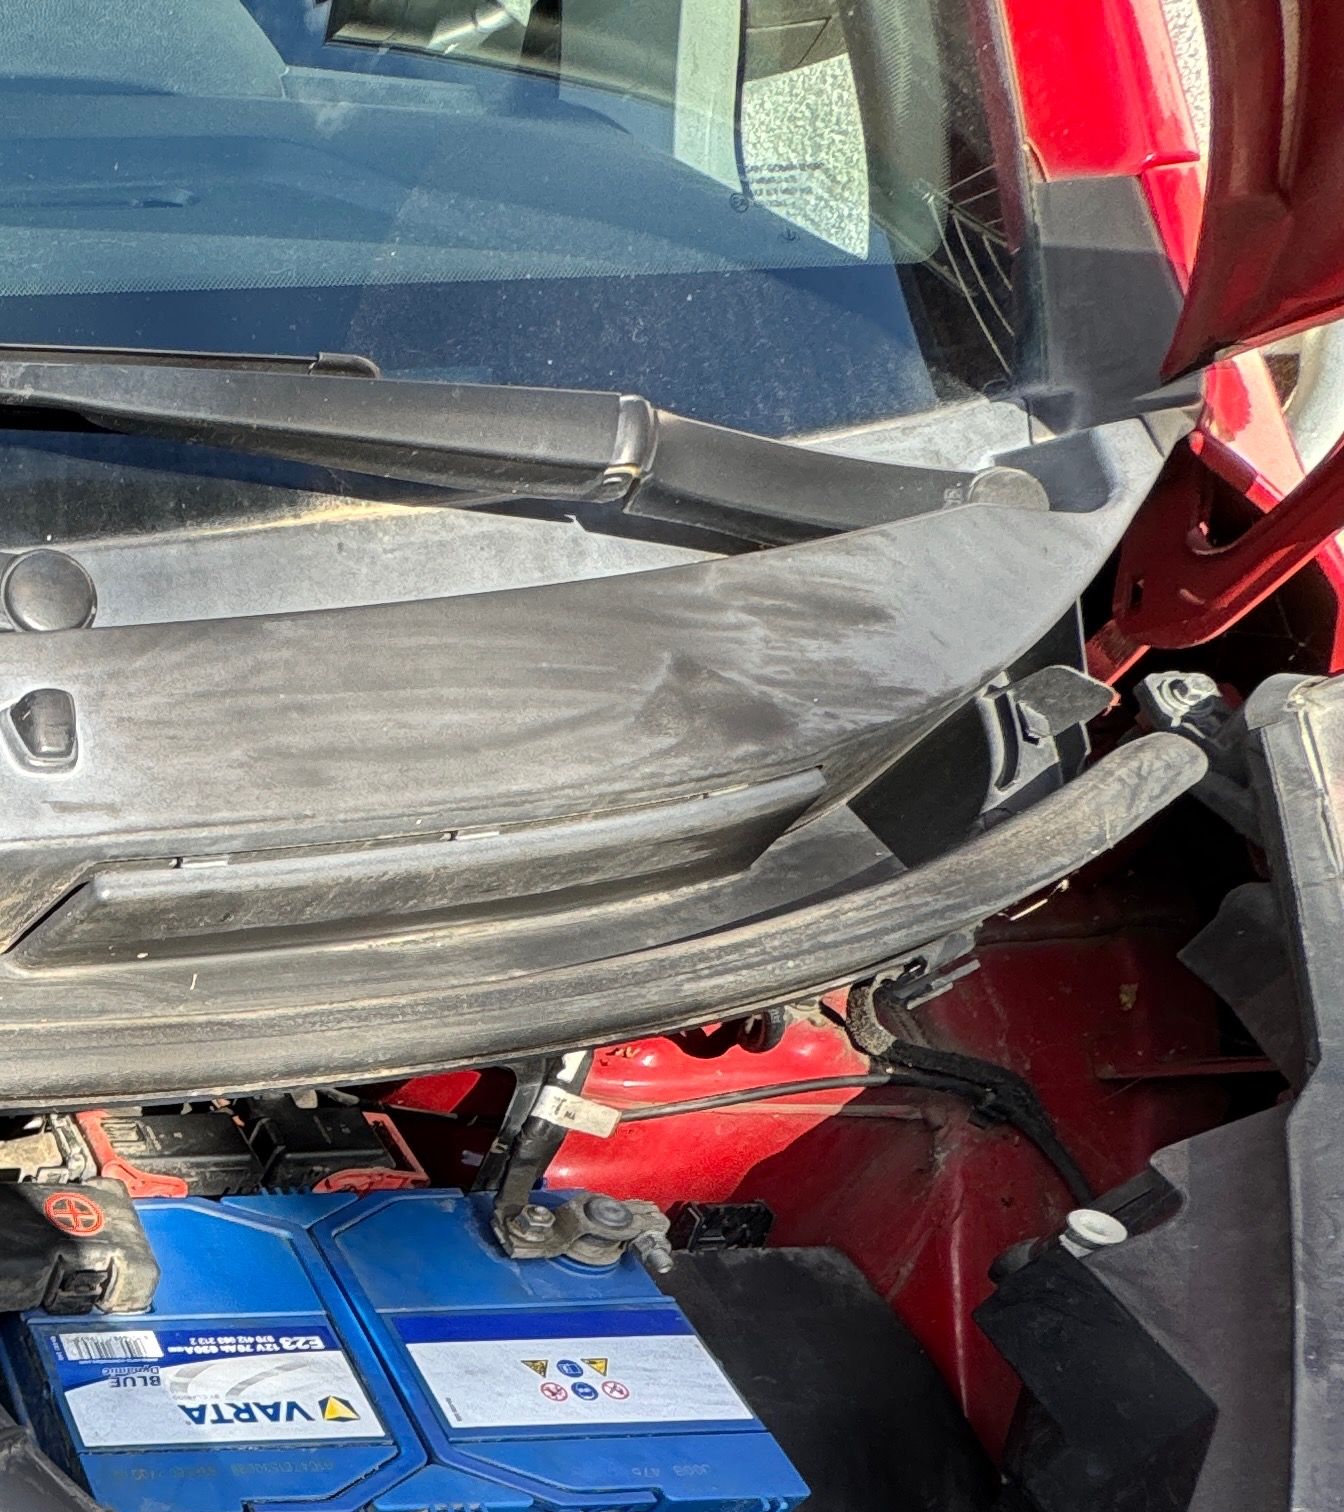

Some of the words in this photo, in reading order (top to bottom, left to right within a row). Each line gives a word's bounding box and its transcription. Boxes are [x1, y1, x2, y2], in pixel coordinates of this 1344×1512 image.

[279, 1336, 325, 1350] E23
[110, 1375, 161, 1387] BLUE
[178, 1401, 315, 1425] VARTA
